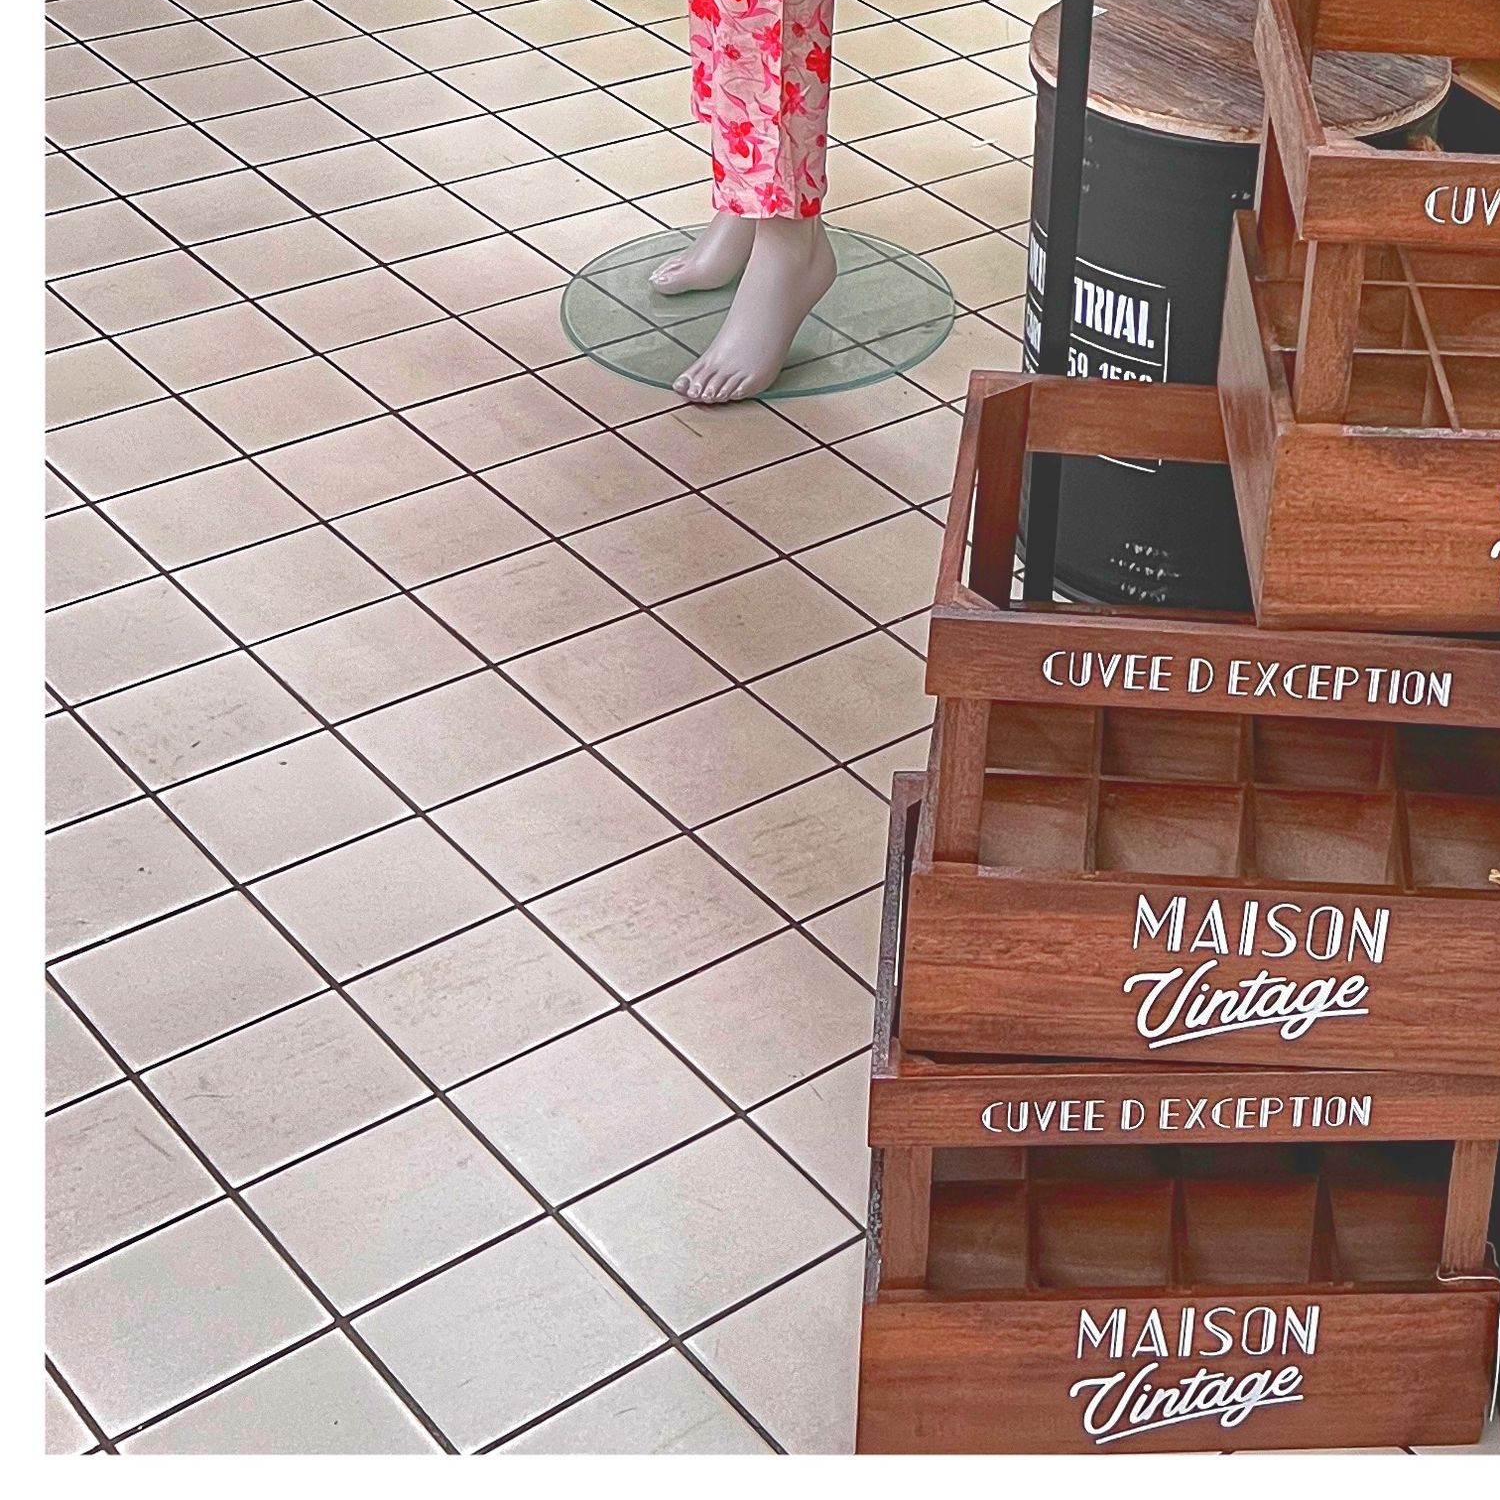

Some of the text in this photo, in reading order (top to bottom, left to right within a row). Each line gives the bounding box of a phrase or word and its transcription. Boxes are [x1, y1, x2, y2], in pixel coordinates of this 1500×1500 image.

[1041, 650, 1453, 708] CUVEE D EXCEPTION
[1132, 893, 1391, 964] MAISON
[1122, 959, 1371, 1050] Vintage
[980, 1094, 1373, 1134] CUVEE D EXCEPTION
[1076, 1304, 1321, 1360] MAISON
[1068, 1362, 1305, 1446] Vintage
